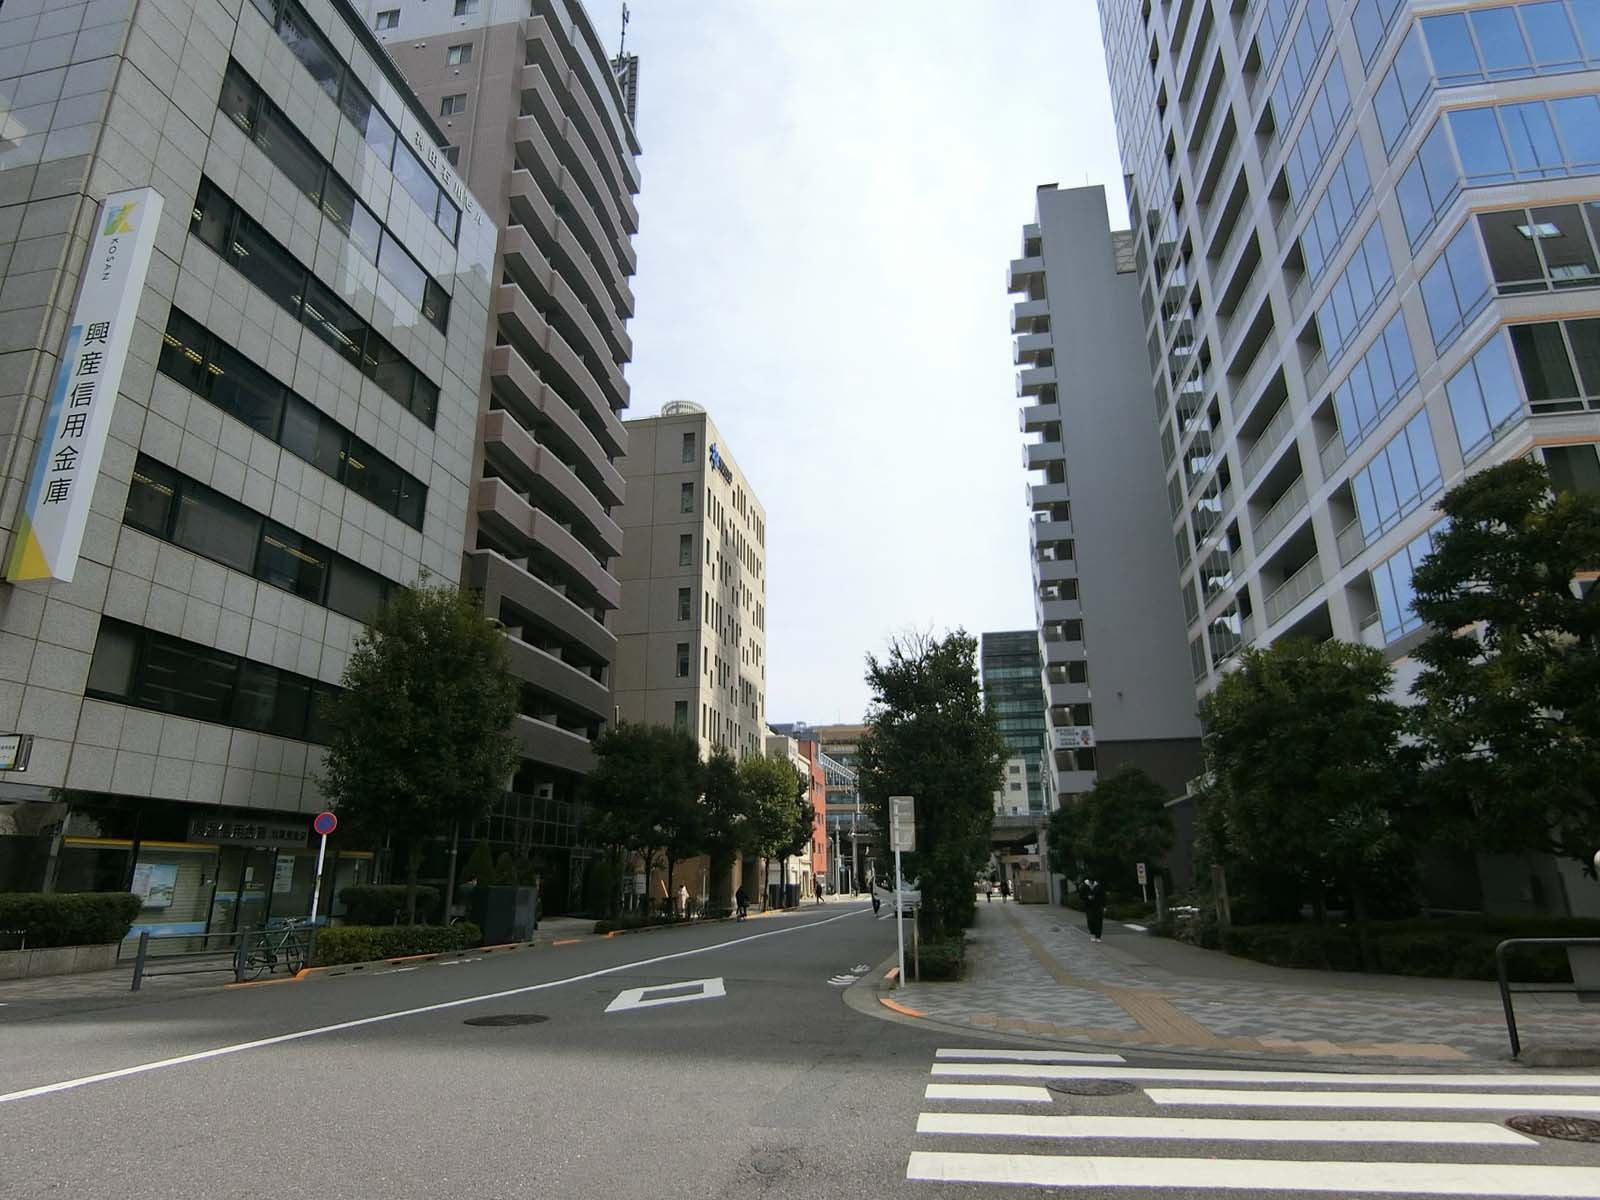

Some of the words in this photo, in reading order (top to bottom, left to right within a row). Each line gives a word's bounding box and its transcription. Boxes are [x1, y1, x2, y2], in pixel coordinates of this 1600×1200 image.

[101, 238, 120, 282] KOSAN
[43, 321, 111, 505] 興産信用金庫
